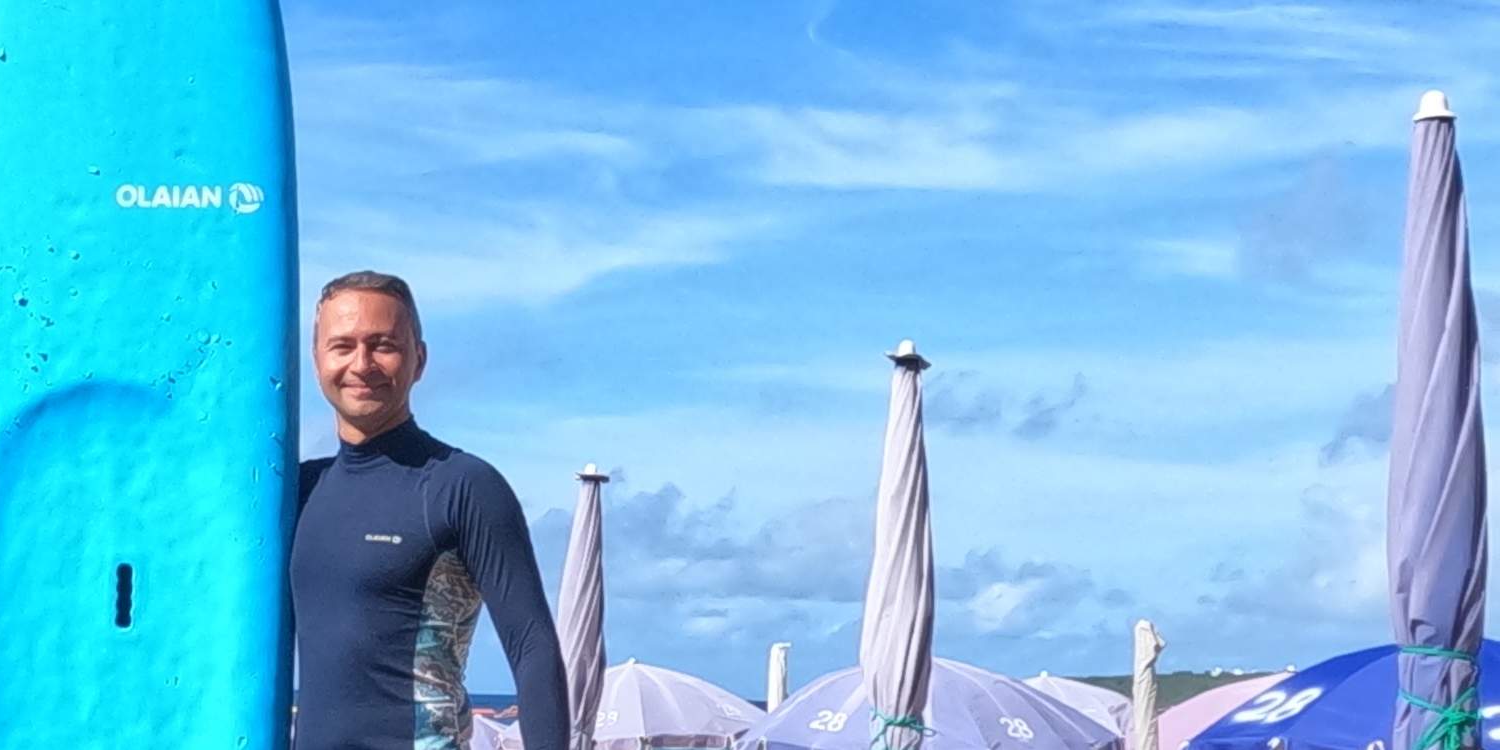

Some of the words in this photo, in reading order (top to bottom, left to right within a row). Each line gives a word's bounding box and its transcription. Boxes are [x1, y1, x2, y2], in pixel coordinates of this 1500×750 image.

[115, 183, 222, 209] OLAIAN
[1233, 687, 1324, 724] 28
[809, 709, 848, 732] 28
[999, 716, 1035, 739] 28
